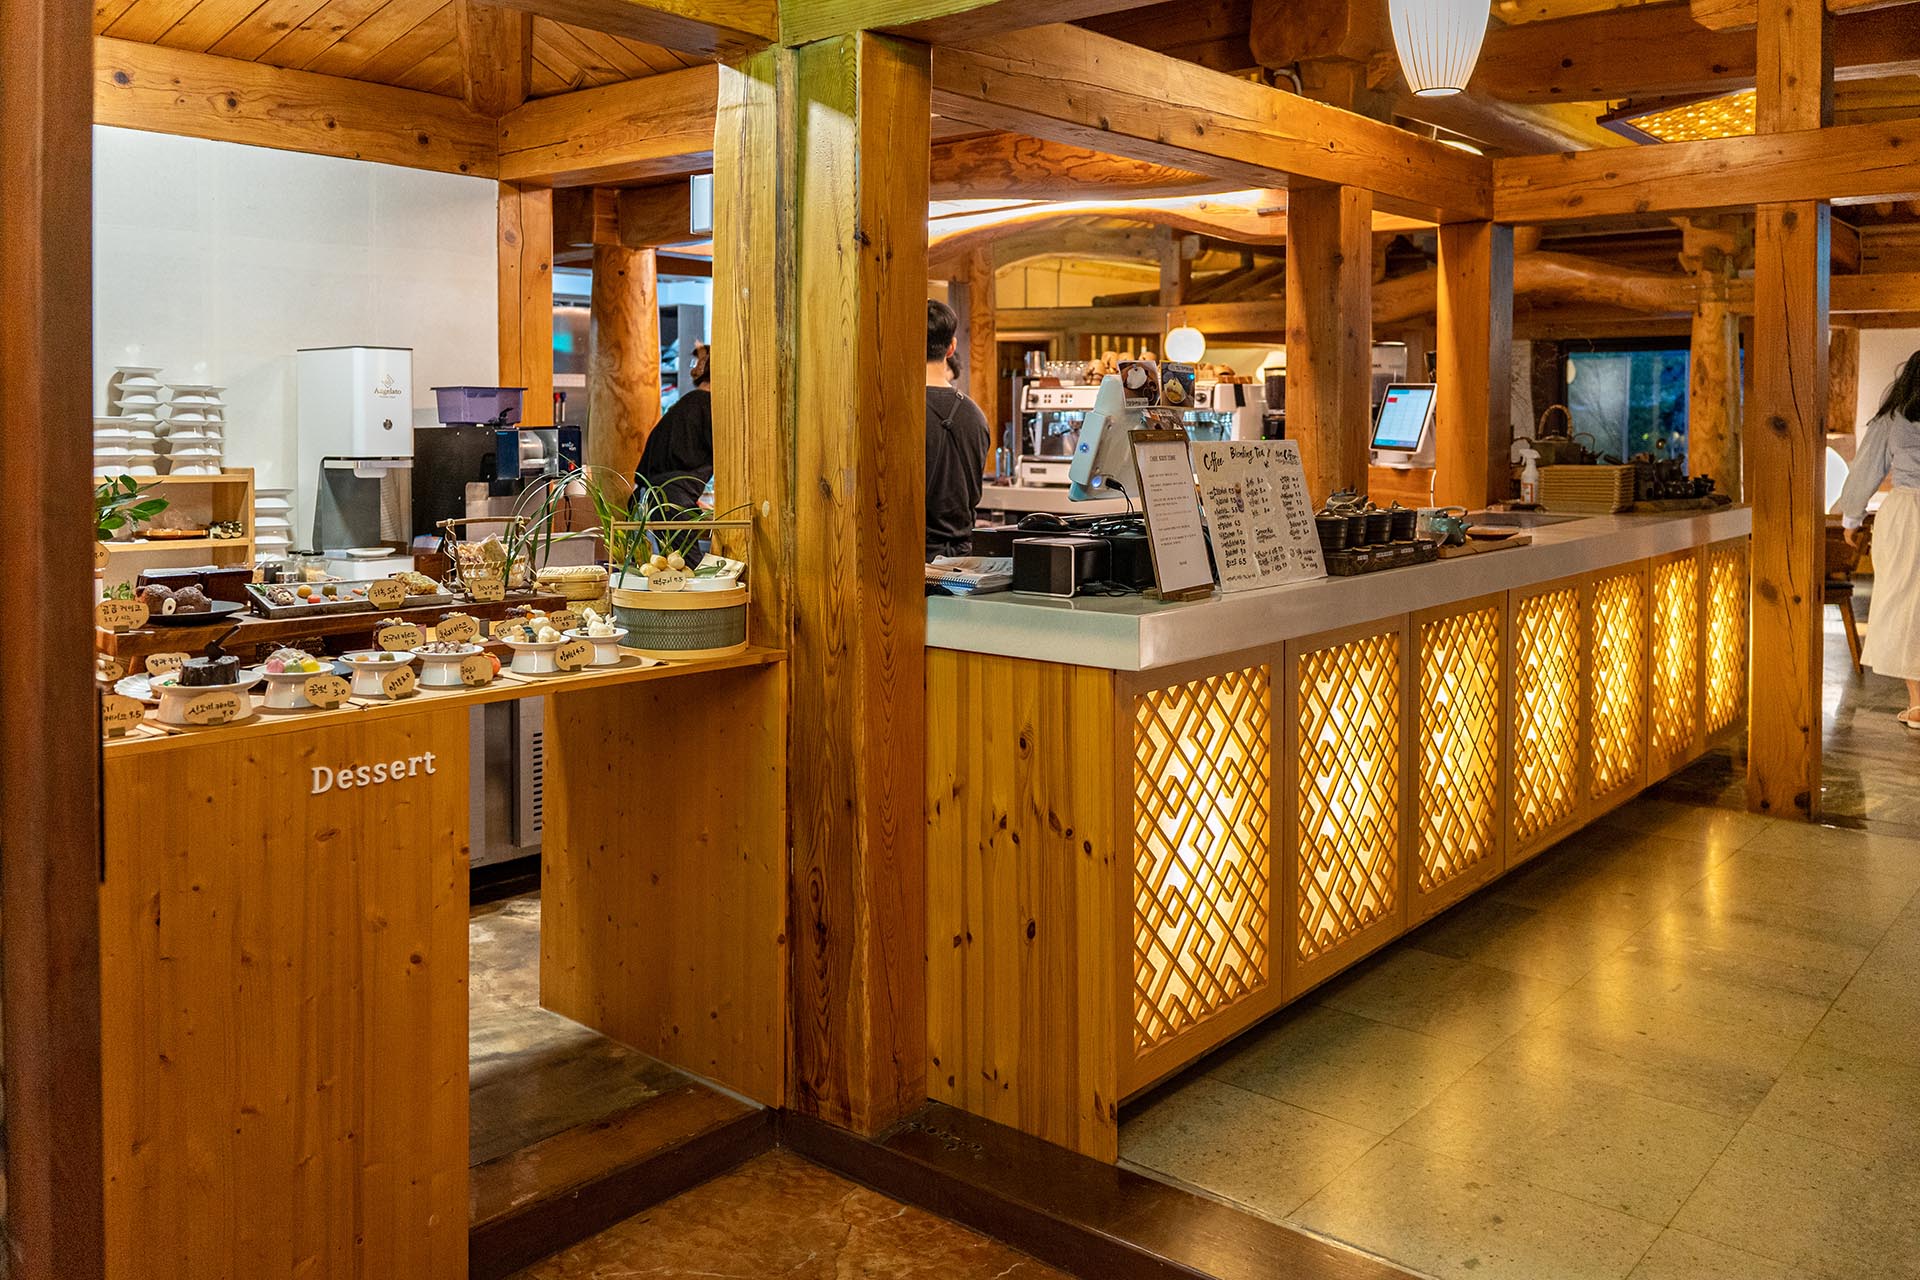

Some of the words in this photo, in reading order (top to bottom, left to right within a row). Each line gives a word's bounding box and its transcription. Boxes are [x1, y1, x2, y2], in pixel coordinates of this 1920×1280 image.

[1254, 446, 1265, 459] Tea
[1203, 451, 1225, 473] Coffee
[334, 688, 346, 697] 3.0
[128, 710, 142, 719] 9.5
[311, 751, 437, 794] Dessert
